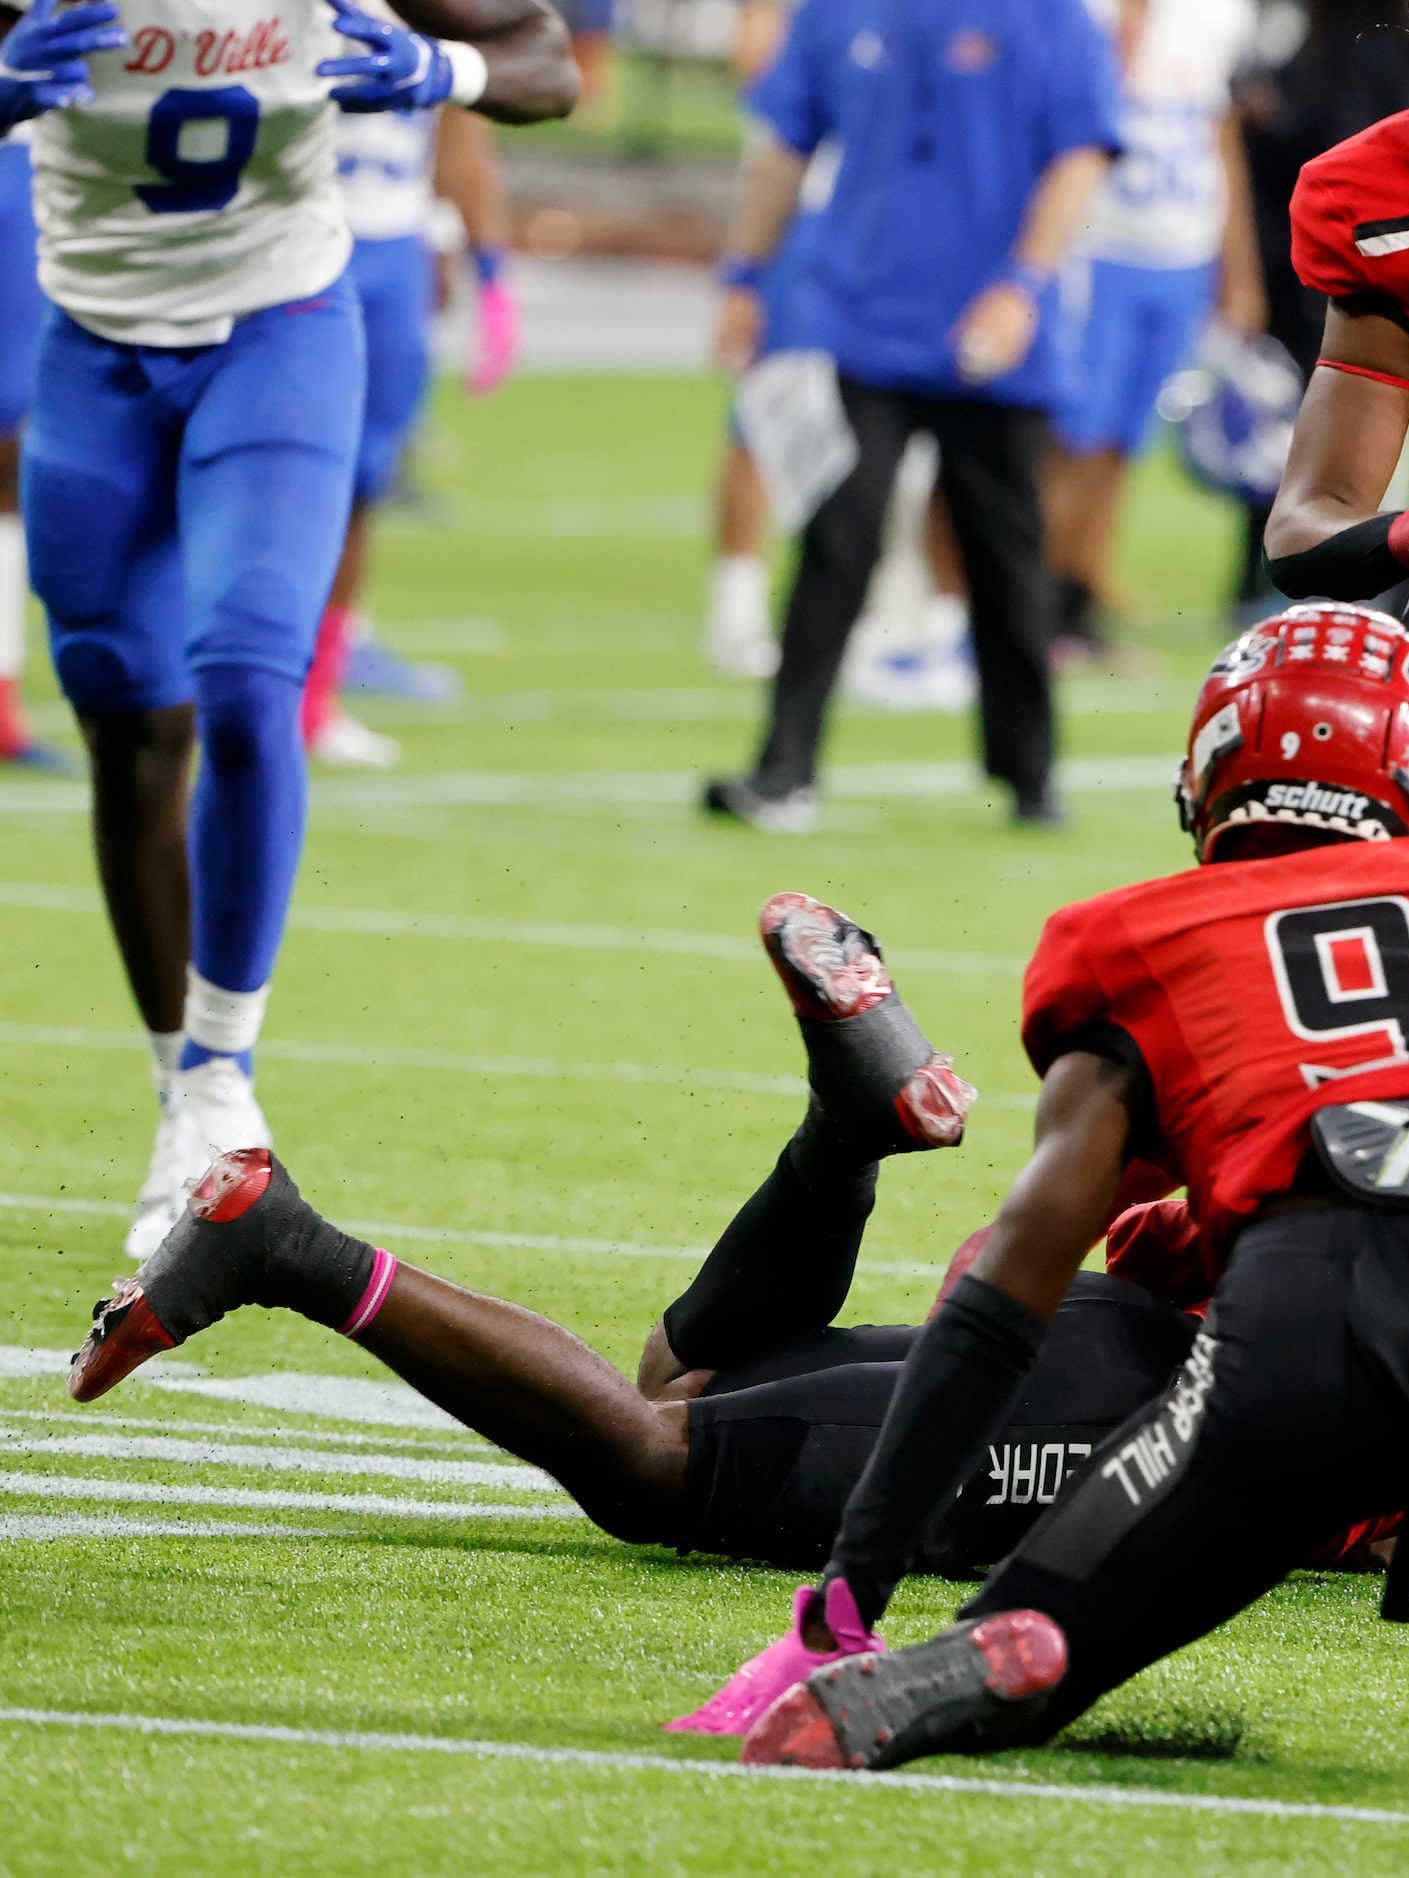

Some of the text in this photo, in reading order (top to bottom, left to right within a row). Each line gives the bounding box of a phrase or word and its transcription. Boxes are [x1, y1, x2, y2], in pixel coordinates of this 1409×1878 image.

[132, 84, 260, 214] 9
[1280, 731, 1301, 760] 9
[1263, 781, 1369, 820] schutt
[1101, 1421, 1177, 1506] HILL
